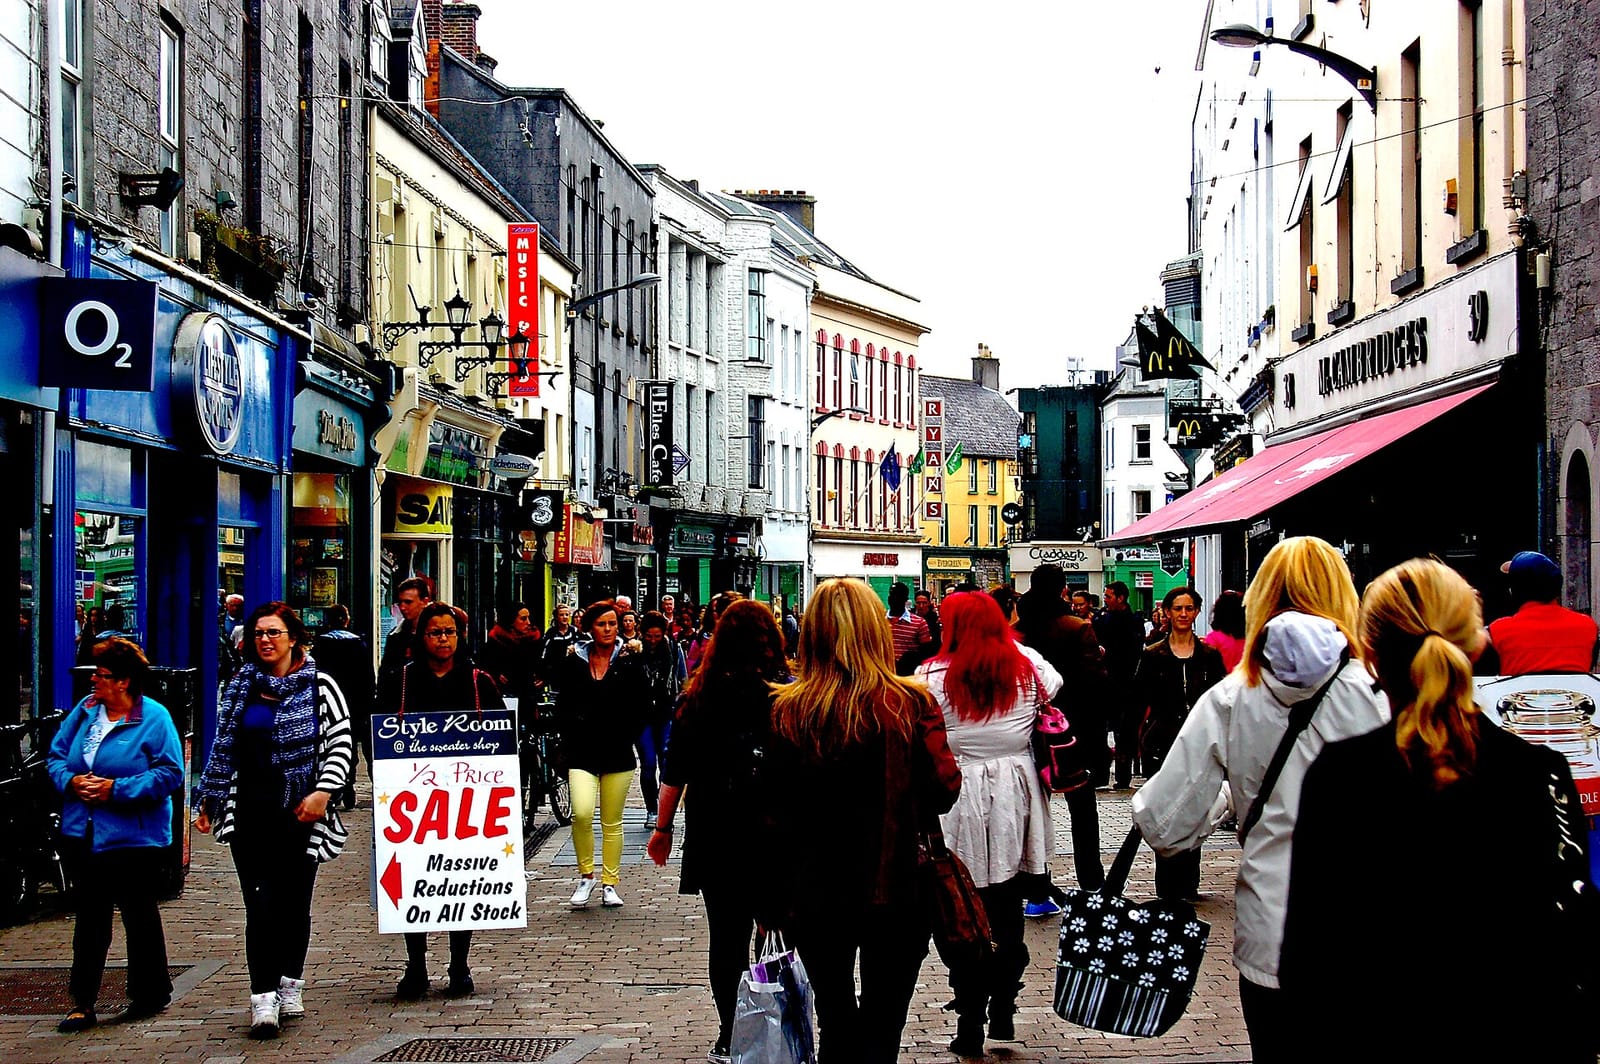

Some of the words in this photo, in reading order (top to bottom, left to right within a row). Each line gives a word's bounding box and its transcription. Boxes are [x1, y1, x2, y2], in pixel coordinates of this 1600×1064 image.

[516, 237, 529, 308] MUSIC
[64, 300, 133, 368] O2
[1468, 290, 1489, 343] 39
[202, 344, 239, 386] LIFESTYLE
[202, 390, 235, 431] SPORTS
[651, 399, 668, 440] Elles
[493, 458, 531, 470] ticketmaster
[651, 444, 668, 483] Cafe
[928, 402, 940, 517] RYANS
[531, 495, 553, 526] 3
[1029, 547, 1088, 562] Claddagh
[377, 716, 438, 739] Style
[443, 713, 513, 734] Room
[393, 741, 405, 753] @
[409, 738, 428, 752] the
[429, 740, 471, 753] sweater
[472, 737, 500, 755] shop
[383, 786, 515, 844] SALE
[426, 854, 498, 872] Massive
[413, 877, 513, 897] Reductions
[406, 905, 430, 924] On
[437, 902, 466, 923] All
[470, 900, 522, 921] Stock
